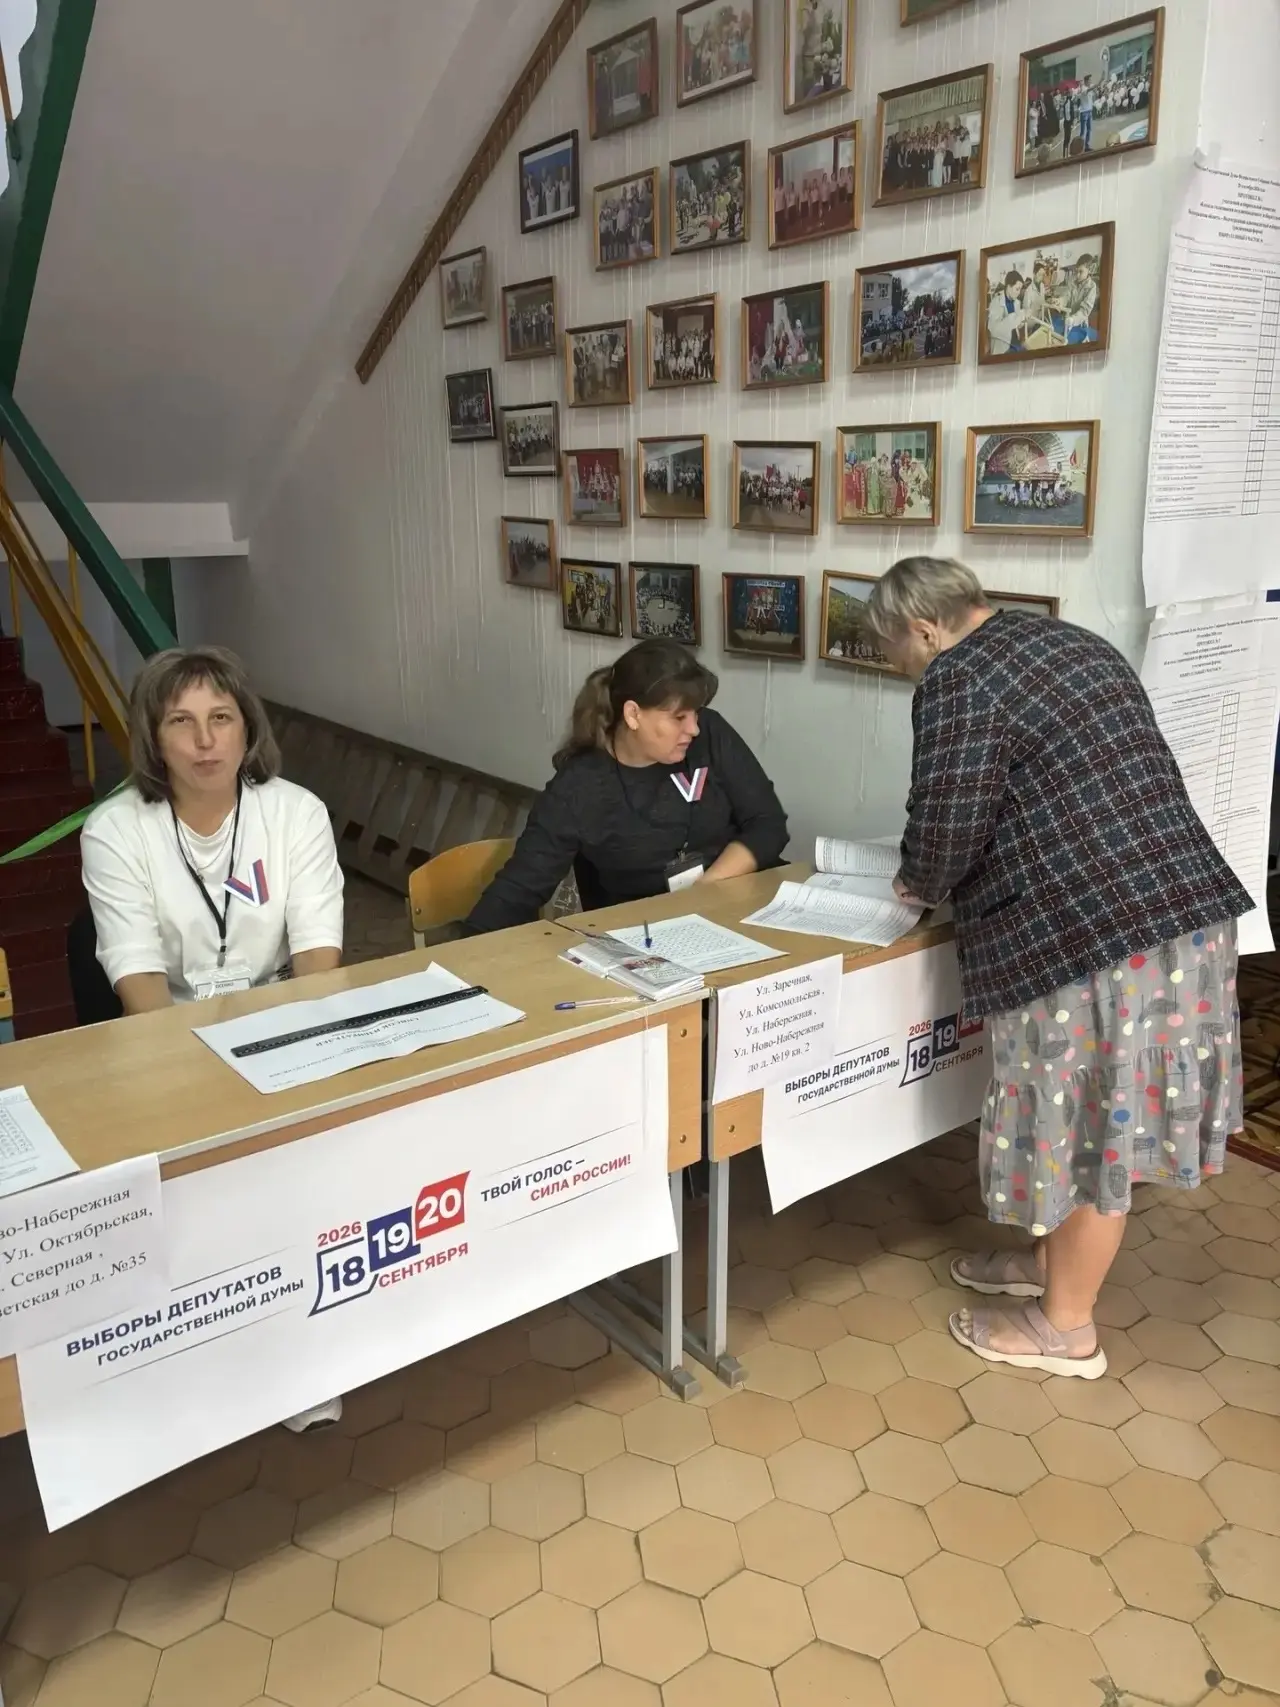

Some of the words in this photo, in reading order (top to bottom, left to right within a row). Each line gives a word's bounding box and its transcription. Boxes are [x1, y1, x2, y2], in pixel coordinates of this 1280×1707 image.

[756, 986, 771, 996] Ул.
[739, 1009, 754, 1020] Ул.
[745, 1026, 760, 1037] Ул.
[909, 1020, 932, 1036] 2026
[734, 1047, 749, 1058] Ул.
[751, 1022, 825, 1053] Ново-Набережная
[747, 1063, 759, 1073] до
[760, 1060, 769, 1069] д.
[770, 1050, 790, 1065] №19
[804, 1042, 810, 1052] 2
[910, 1045, 930, 1072] 18
[935, 1024, 956, 1050] 19
[935, 1046, 983, 1072] СЕНТЯБРЯ
[785, 1067, 831, 1094] ВЫБОРЫ
[832, 1046, 890, 1078] ДЕПУТАТОВ
[797, 1065, 876, 1104] ГОСУДАРСТВЕННОЙ
[876, 1058, 900, 1076] ДУМЫ
[481, 1178, 522, 1202] ТВОЙ
[525, 1159, 572, 1187] ГОЛОС
[530, 1180, 570, 1201] СИЛА
[572, 1154, 631, 1186] РОССИИ!
[3, 1248, 33, 1264] Ул.
[40, 1207, 153, 1252] Октябрьская,
[317, 1221, 362, 1247] 2026
[326, 1256, 364, 1292] 18
[371, 1222, 410, 1259] 19
[418, 1188, 461, 1228] 20
[11, 1251, 93, 1287] Северная
[65, 1279, 85, 1296] до
[90, 1272, 105, 1285] д.
[110, 1252, 147, 1276] №35
[378, 1242, 469, 1288] СЕНТЯБРЯ
[66, 1309, 162, 1357] ВЫБОРЫ
[168, 1266, 282, 1320] ДЕПУТАТОВ
[97, 1295, 256, 1366] ГОСУДАРСТВЕННОЙ
[260, 1279, 304, 1306] ДУМЫ
